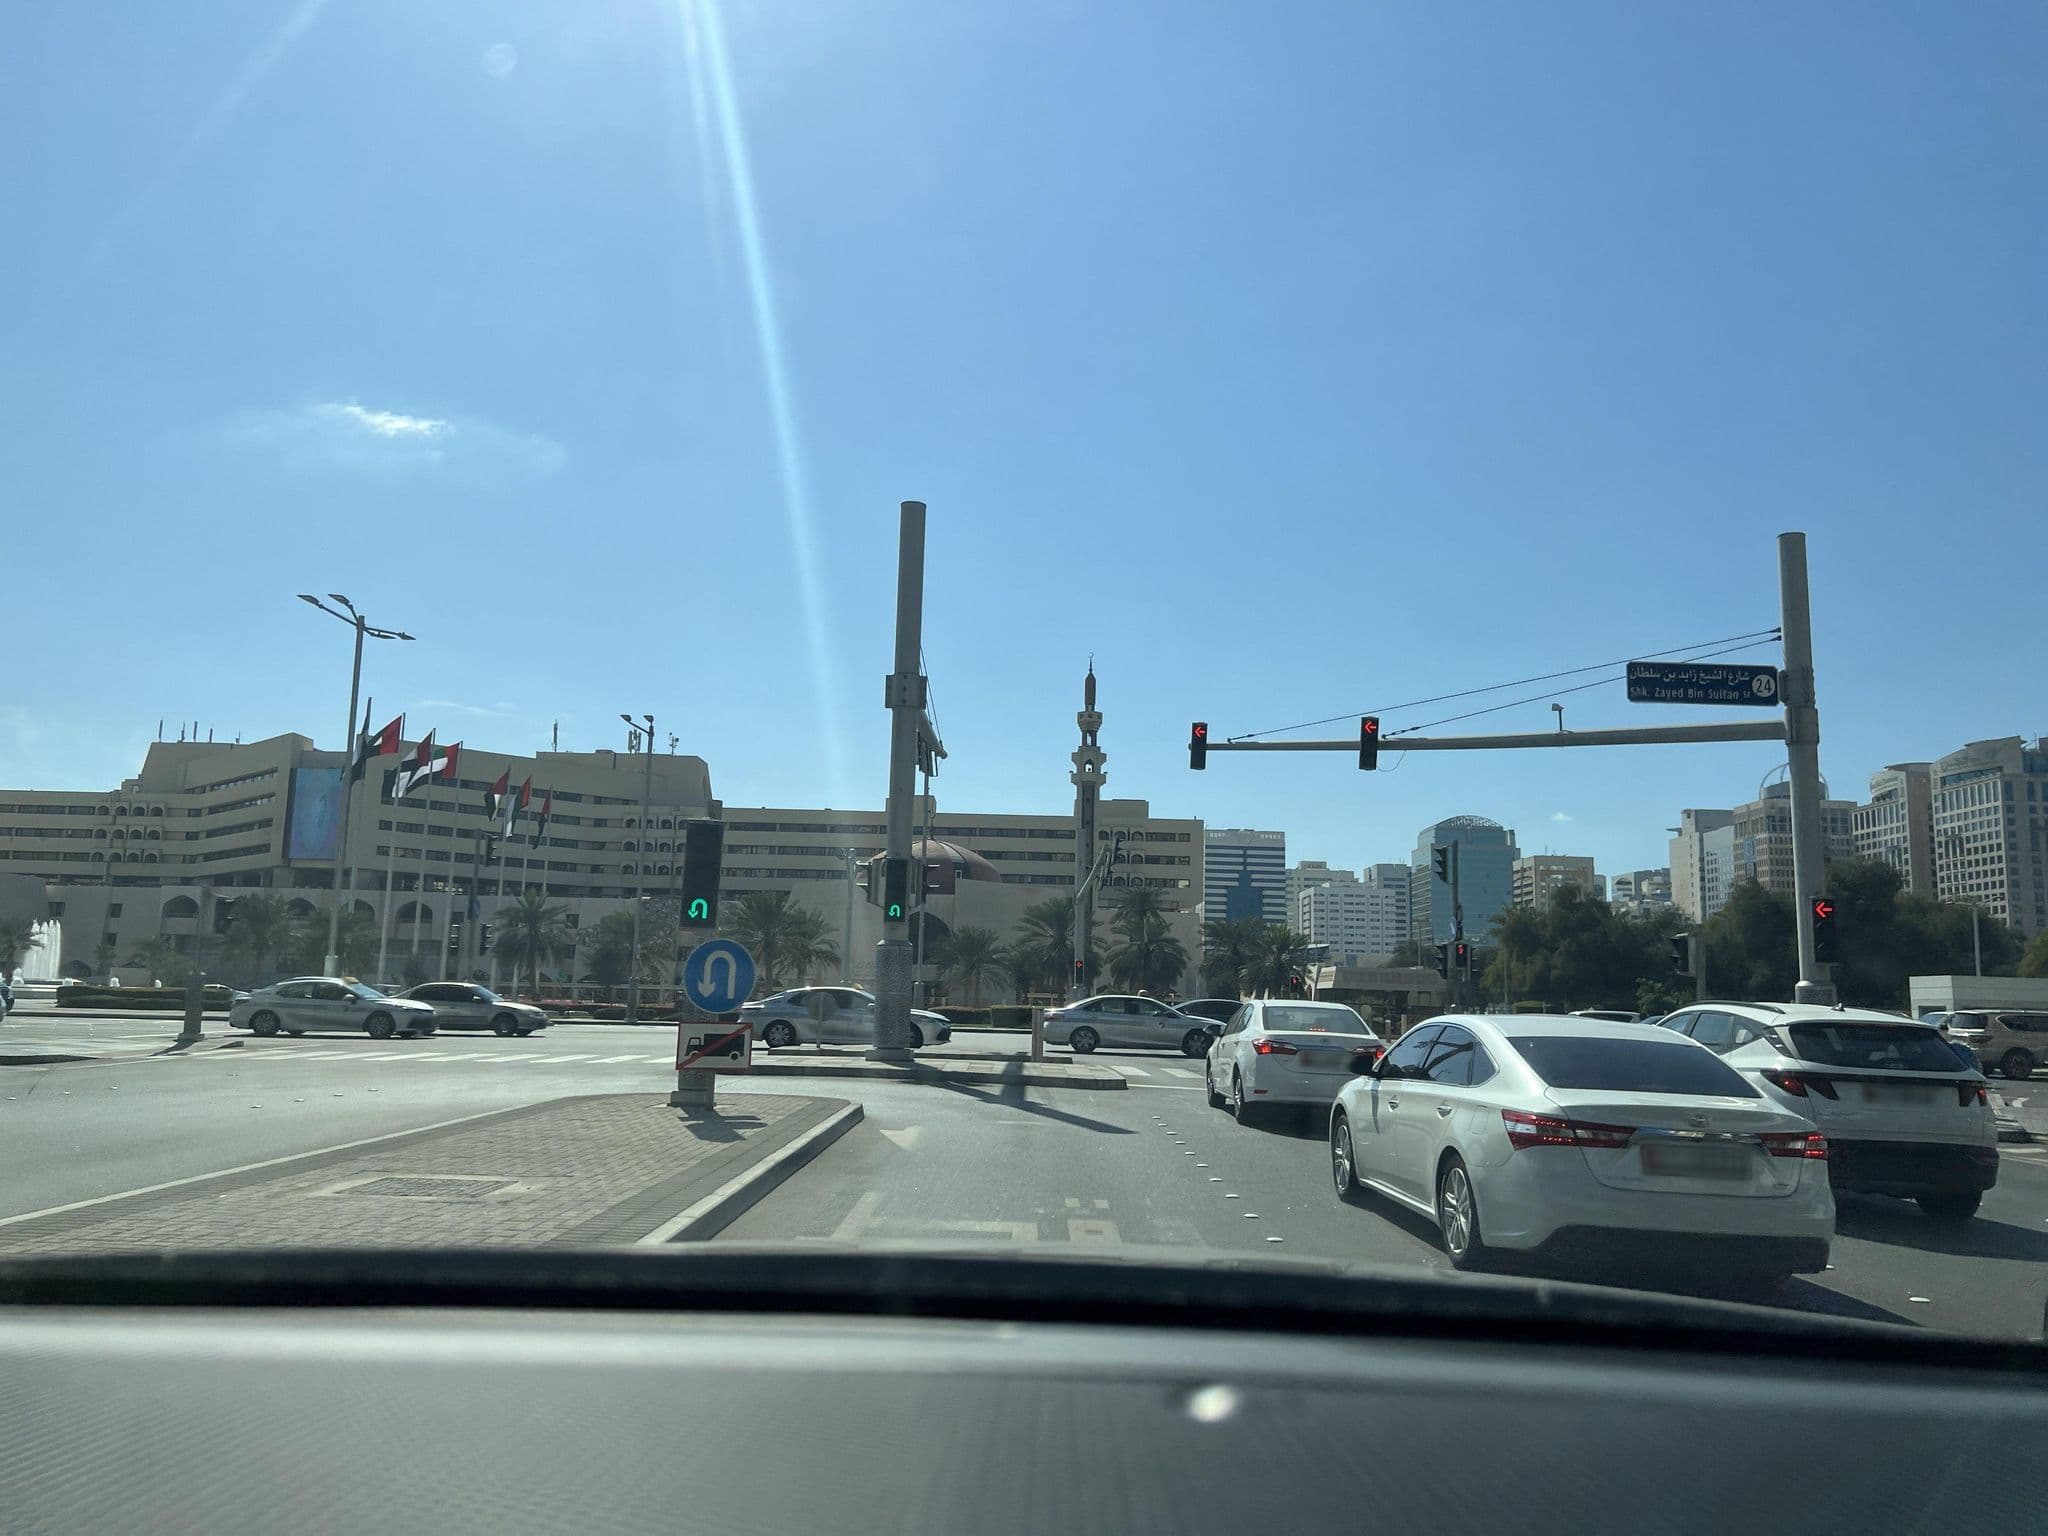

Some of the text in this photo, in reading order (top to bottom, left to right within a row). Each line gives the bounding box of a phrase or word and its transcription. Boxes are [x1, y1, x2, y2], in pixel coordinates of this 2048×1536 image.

[1629, 666, 1750, 686] شارع الشيخ زايد بن سلطان
[1630, 686, 1650, 697] Shk.
[1655, 687, 1684, 700] Zayed
[1688, 688, 1704, 698] Bin
[1708, 688, 1739, 700] Sultan
[1755, 678, 1772, 693] 24
